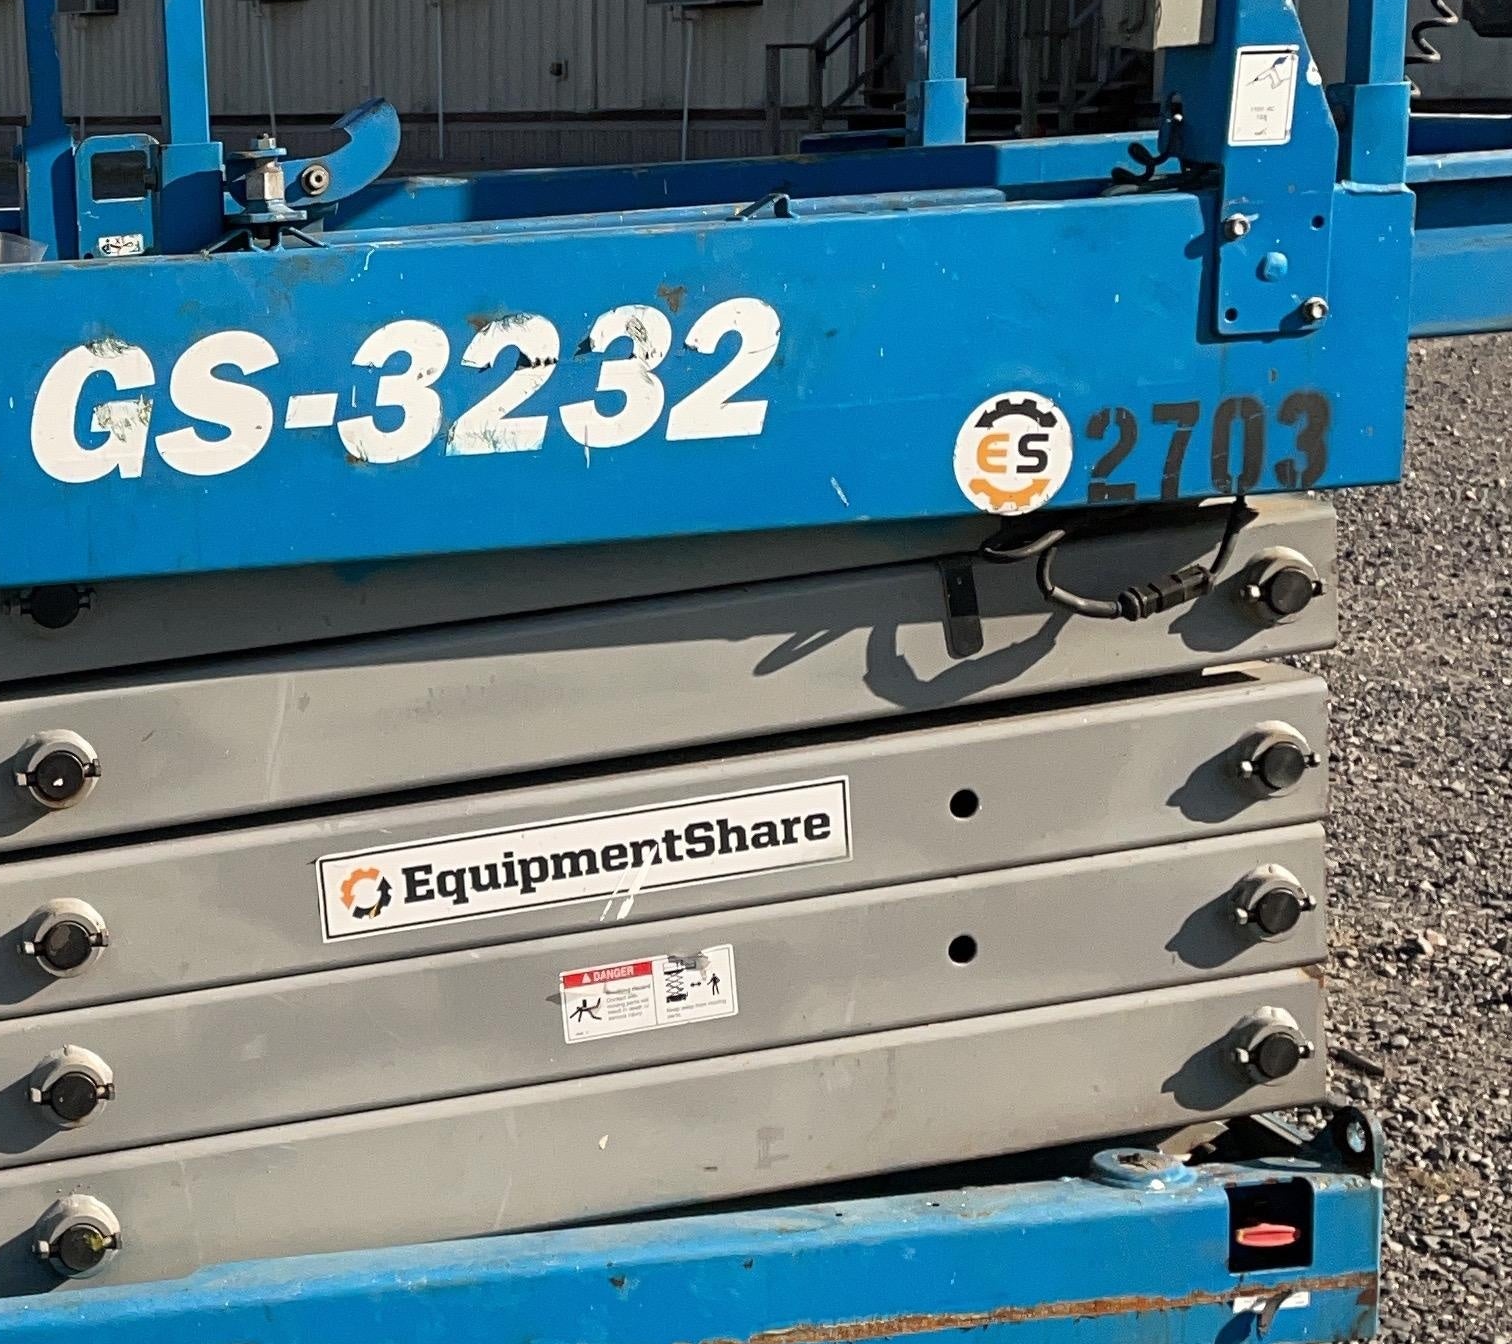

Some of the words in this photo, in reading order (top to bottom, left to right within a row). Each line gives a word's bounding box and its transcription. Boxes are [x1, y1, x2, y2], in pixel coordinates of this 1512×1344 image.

[30, 297, 782, 484] GS-3232
[975, 433, 1050, 474] ES
[1084, 391, 1331, 501] 2703
[402, 812, 832, 905] EquipmentShare
[594, 965, 634, 982] DANGER
